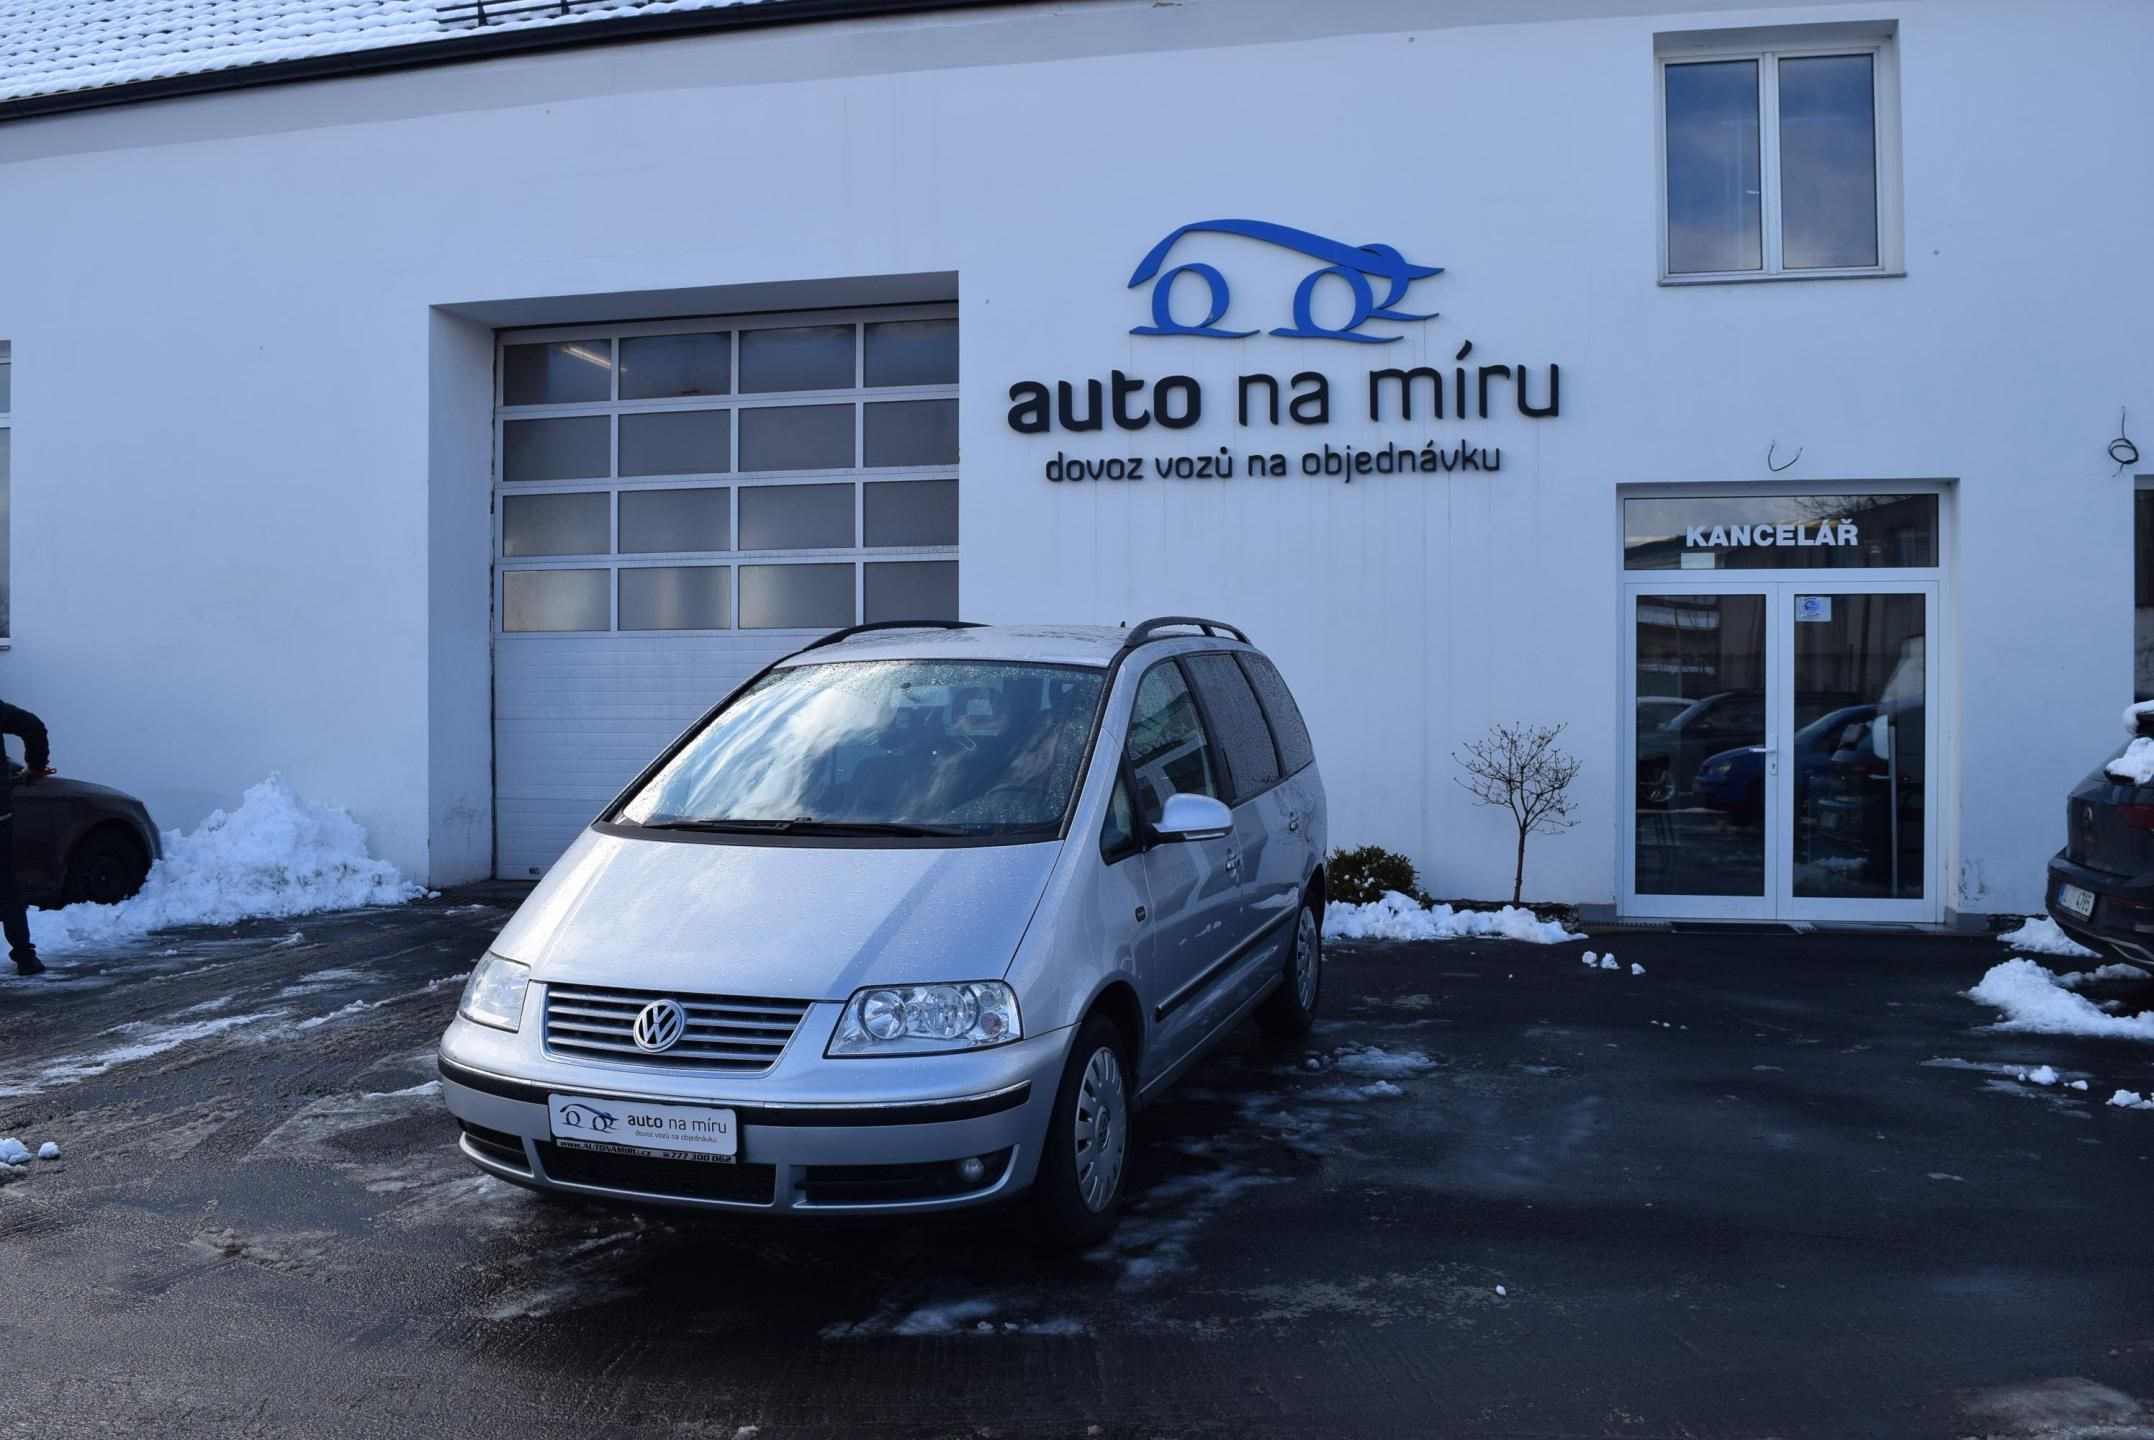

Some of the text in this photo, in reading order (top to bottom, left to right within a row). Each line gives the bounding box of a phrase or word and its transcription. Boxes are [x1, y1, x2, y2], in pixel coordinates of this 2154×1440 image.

[1007, 339, 1560, 434] auto na míru
[1045, 439, 1500, 484] dovoz vozů na objednávku
[1685, 519, 1859, 547] KANCELÁŘ
[627, 1114, 727, 1134] auto na míru
[671, 1151, 688, 1160] 777
[690, 1153, 710, 1161] 300
[711, 1155, 731, 1163] 062
